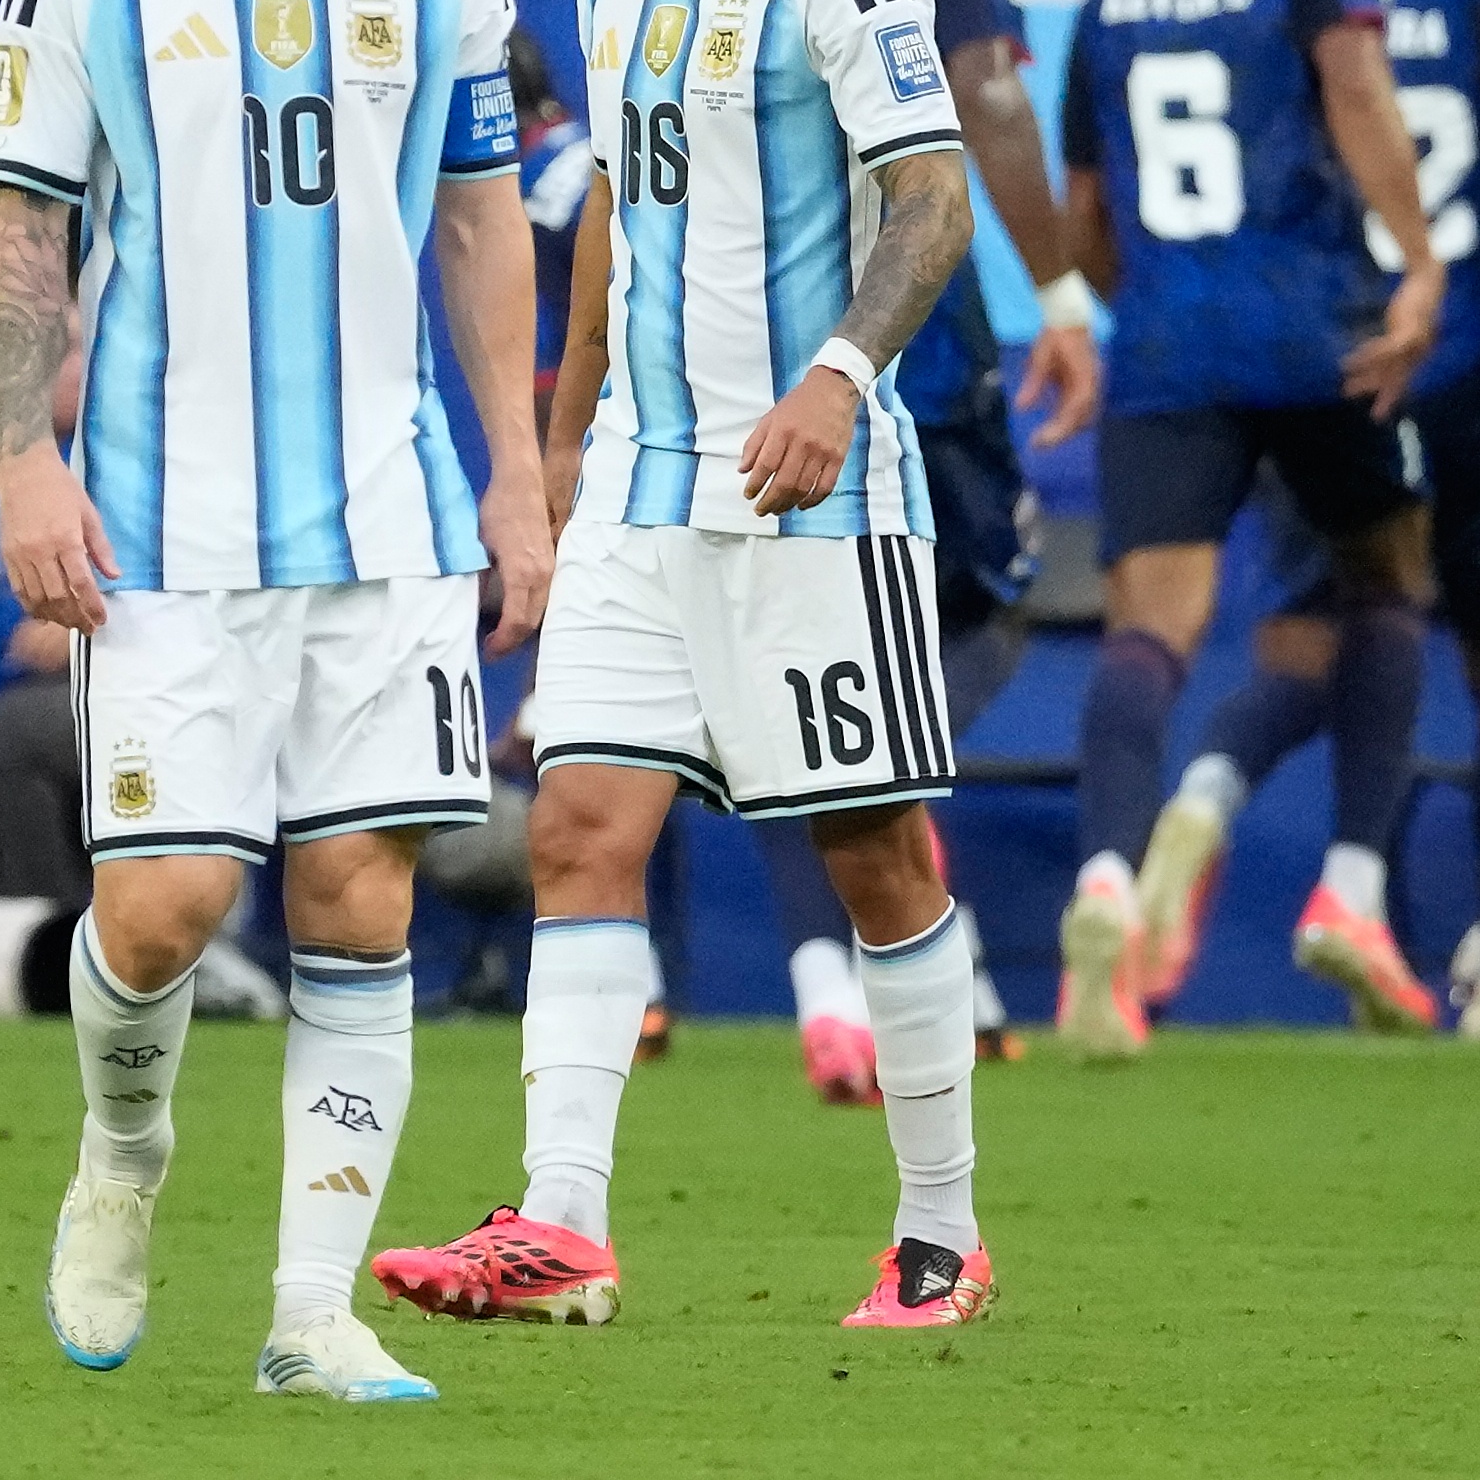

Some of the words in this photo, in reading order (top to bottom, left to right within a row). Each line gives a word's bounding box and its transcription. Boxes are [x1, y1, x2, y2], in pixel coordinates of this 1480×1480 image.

[358, 15, 392, 48] AFA
[707, 31, 733, 61] AFA
[243, 94, 336, 207] 10
[622, 99, 688, 206] 16
[1127, 50, 1247, 241] 6
[426, 665, 481, 778] 10
[784, 660, 874, 771] 16
[117, 772, 147, 801] AFA
[307, 1085, 383, 1131] AFA
